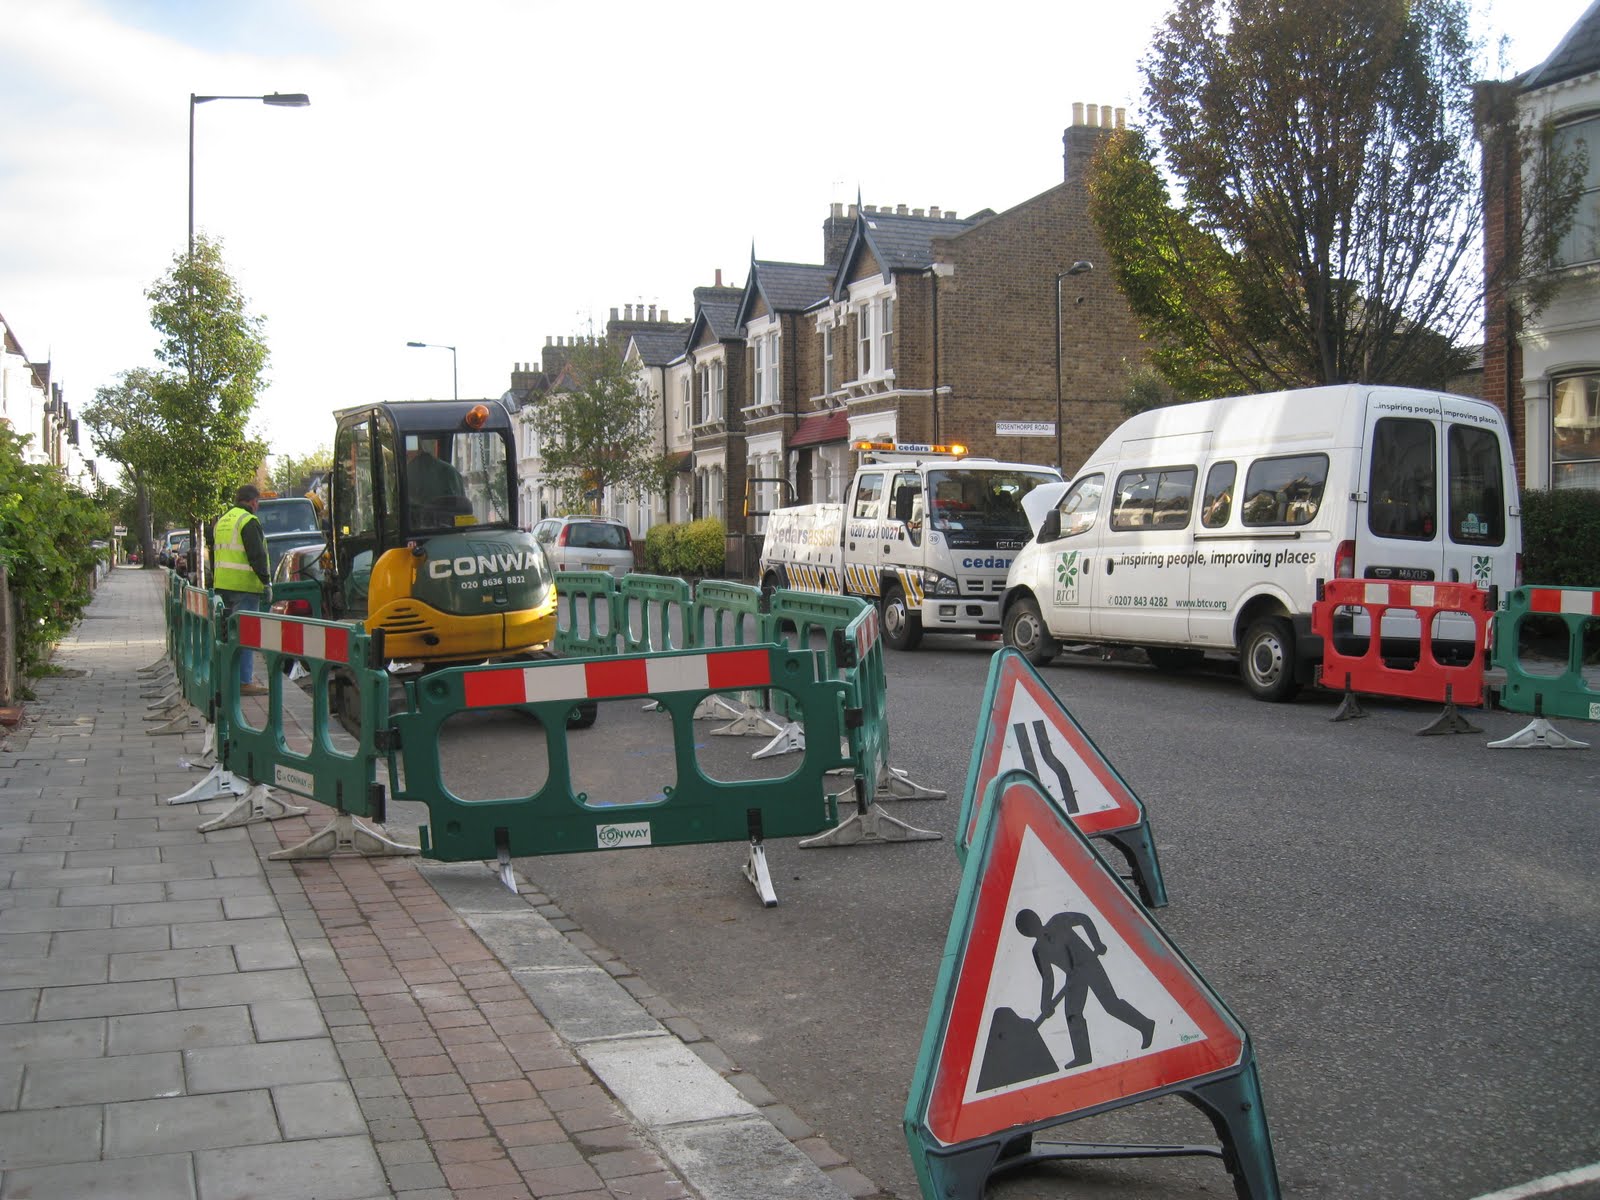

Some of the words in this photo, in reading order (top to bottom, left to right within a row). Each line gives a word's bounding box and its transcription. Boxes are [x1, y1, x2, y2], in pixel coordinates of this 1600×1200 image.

[1443, 408, 1478, 422] improving
[1479, 415, 1498, 425] places
[996, 423, 1033, 431] ROSENTHORPE
[898, 444, 929, 452] cedars
[881, 526, 899, 540] 0027
[930, 535, 939, 543] 39
[962, 555, 1013, 569] cedar
[1167, 551, 1207, 569] people,
[1210, 549, 1272, 568] improving
[1275, 548, 1317, 568] places
[1399, 569, 1429, 581] MAXUS
[461, 581, 478, 590] 020
[482, 578, 503, 588] 8636
[507, 575, 526, 584] 8822
[1056, 589, 1078, 602] BTCV
[1114, 595, 1131, 606] 0207
[1133, 596, 1148, 607] 843
[1149, 596, 1169, 608] 4282
[1175, 598, 1228, 611] www.btcv.org
[599, 828, 649, 841] CONWAY
